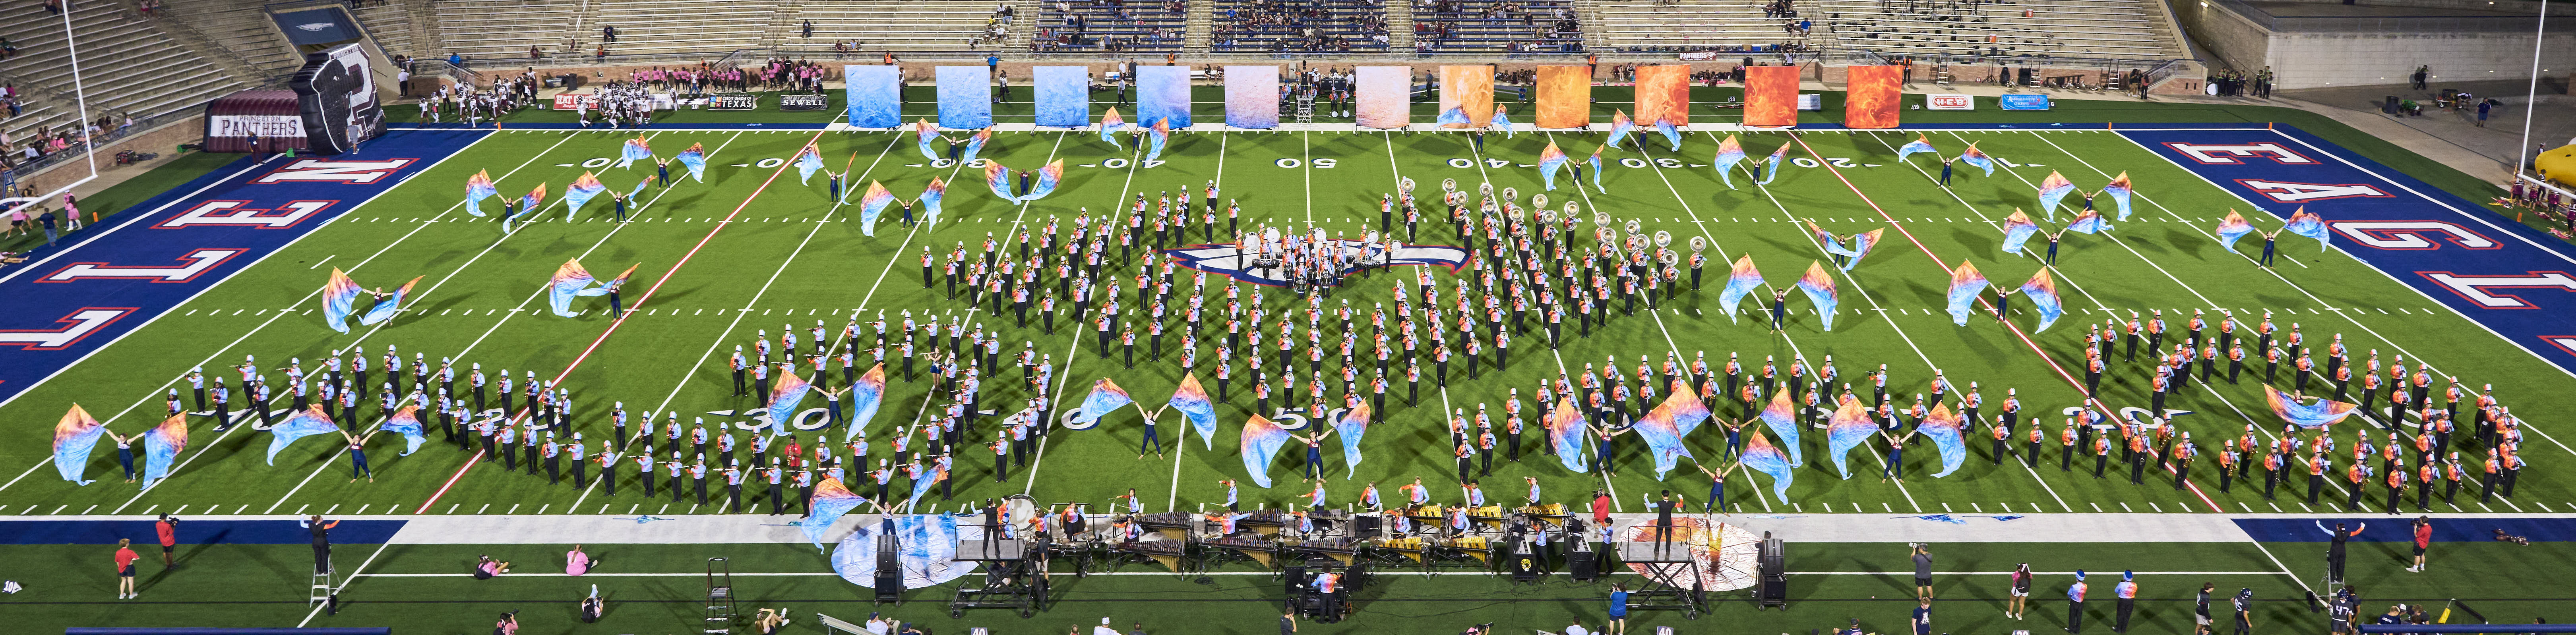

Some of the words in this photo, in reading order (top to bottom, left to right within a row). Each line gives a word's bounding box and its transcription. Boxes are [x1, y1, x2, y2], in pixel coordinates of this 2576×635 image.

[556, 95, 572, 104] HAT
[221, 119, 297, 135] PANTHERS
[4, 580, 14, 592] 10
[2336, 605, 2349, 615] 47
[1920, 612, 1930, 625] A
